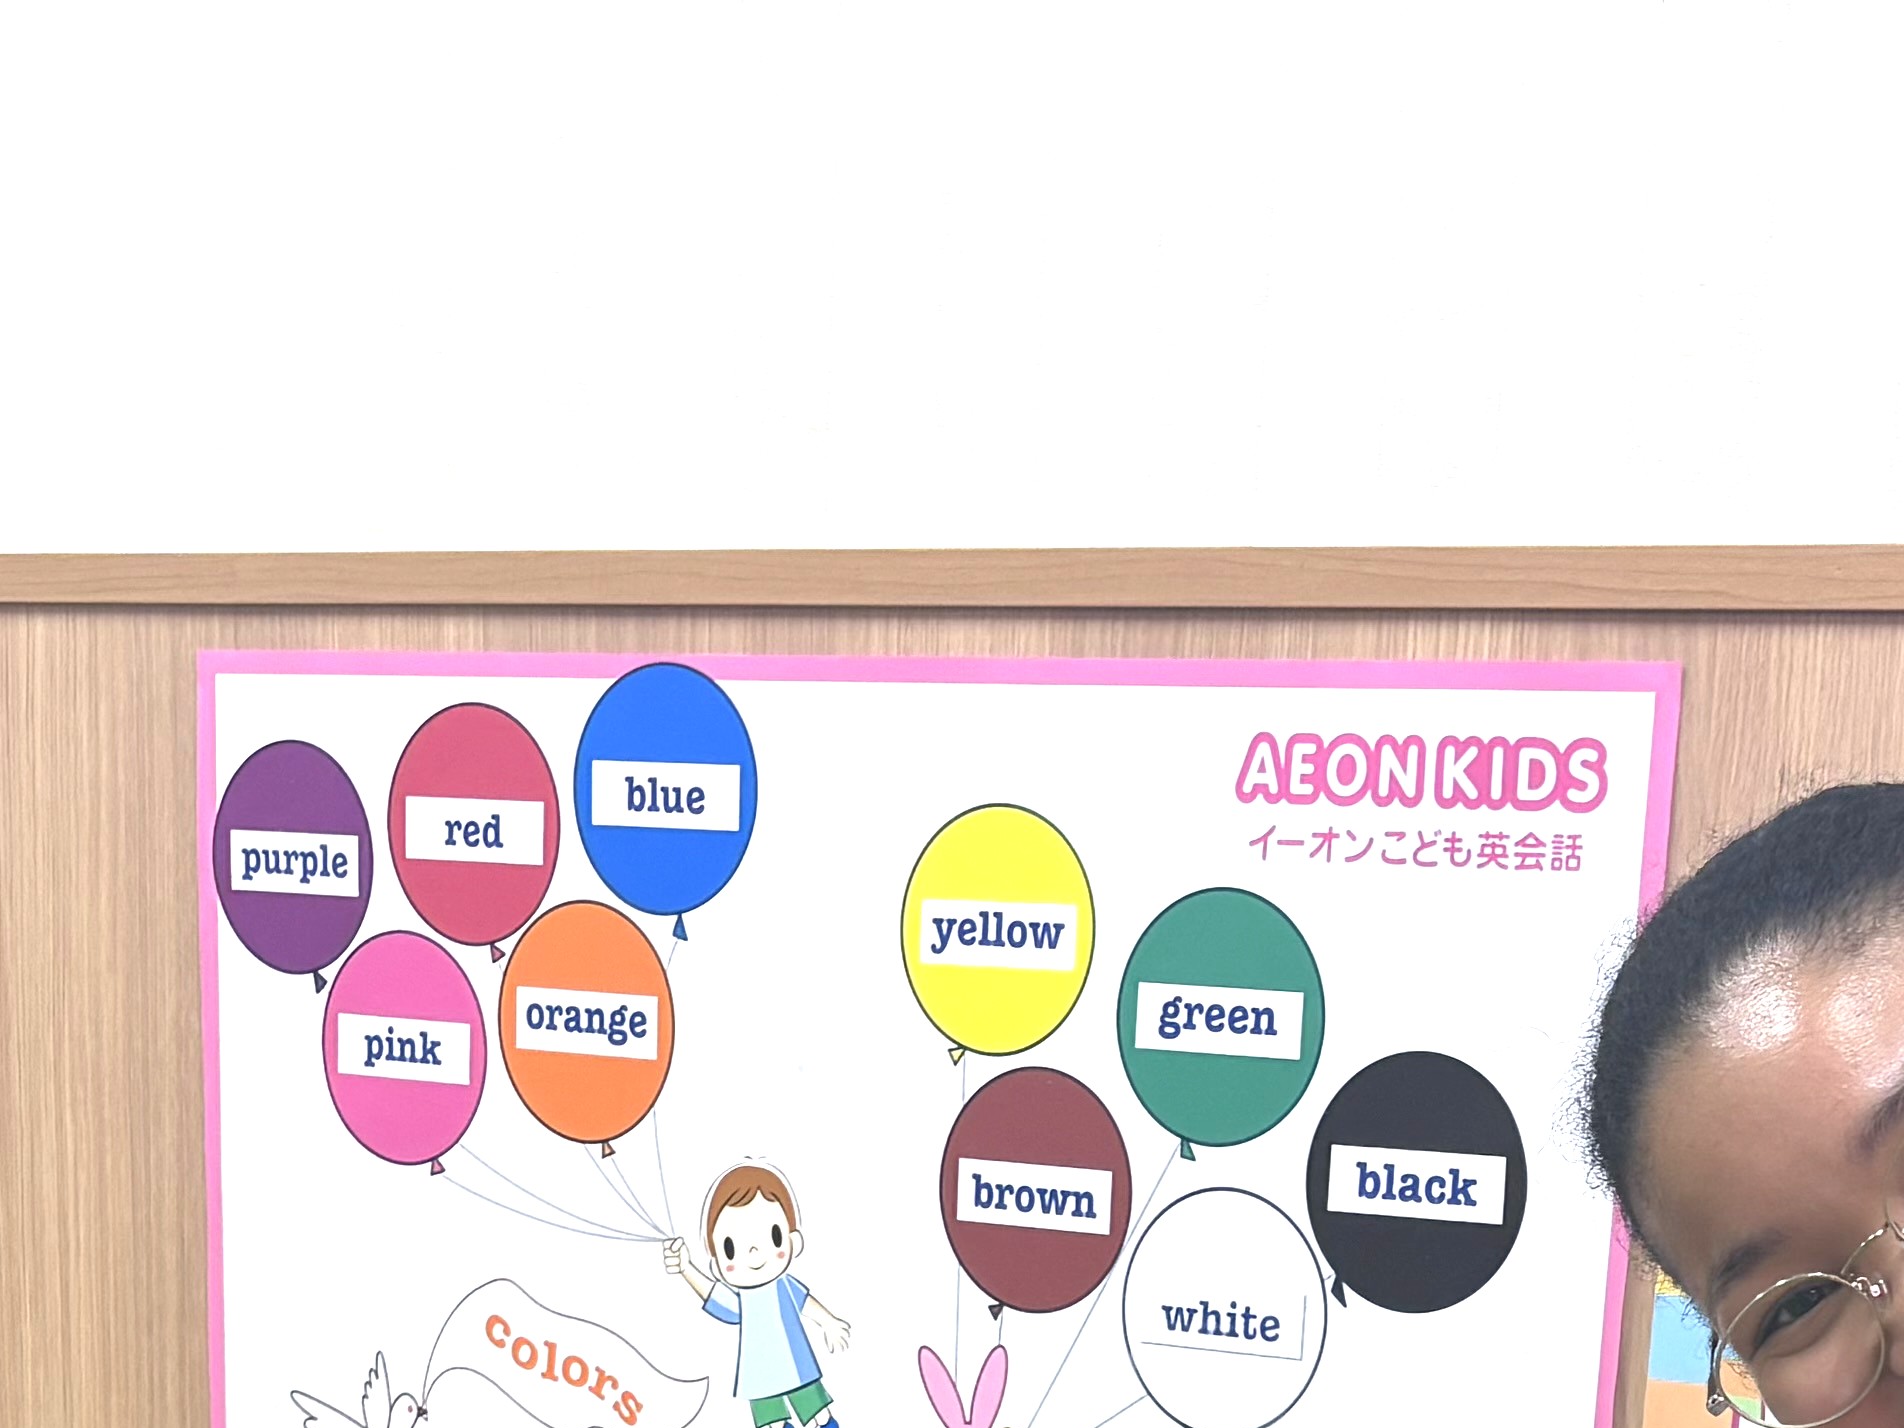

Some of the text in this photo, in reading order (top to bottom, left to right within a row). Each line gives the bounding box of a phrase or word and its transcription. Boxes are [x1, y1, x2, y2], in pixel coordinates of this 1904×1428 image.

[1236, 732, 1608, 814] AEON KIDS
[625, 776, 706, 815] blue
[444, 814, 503, 849] red
[1248, 825, 1583, 873] イーオンこども英会話
[241, 843, 348, 882] purple
[930, 911, 1065, 954] yellow
[526, 1001, 647, 1041] orange
[1158, 995, 1278, 1039] green
[364, 1027, 442, 1067] pink
[971, 1173, 1097, 1219] brown
[1356, 1162, 1477, 1207] black
[1162, 1298, 1281, 1342] white
[485, 1314, 644, 1427] colors
